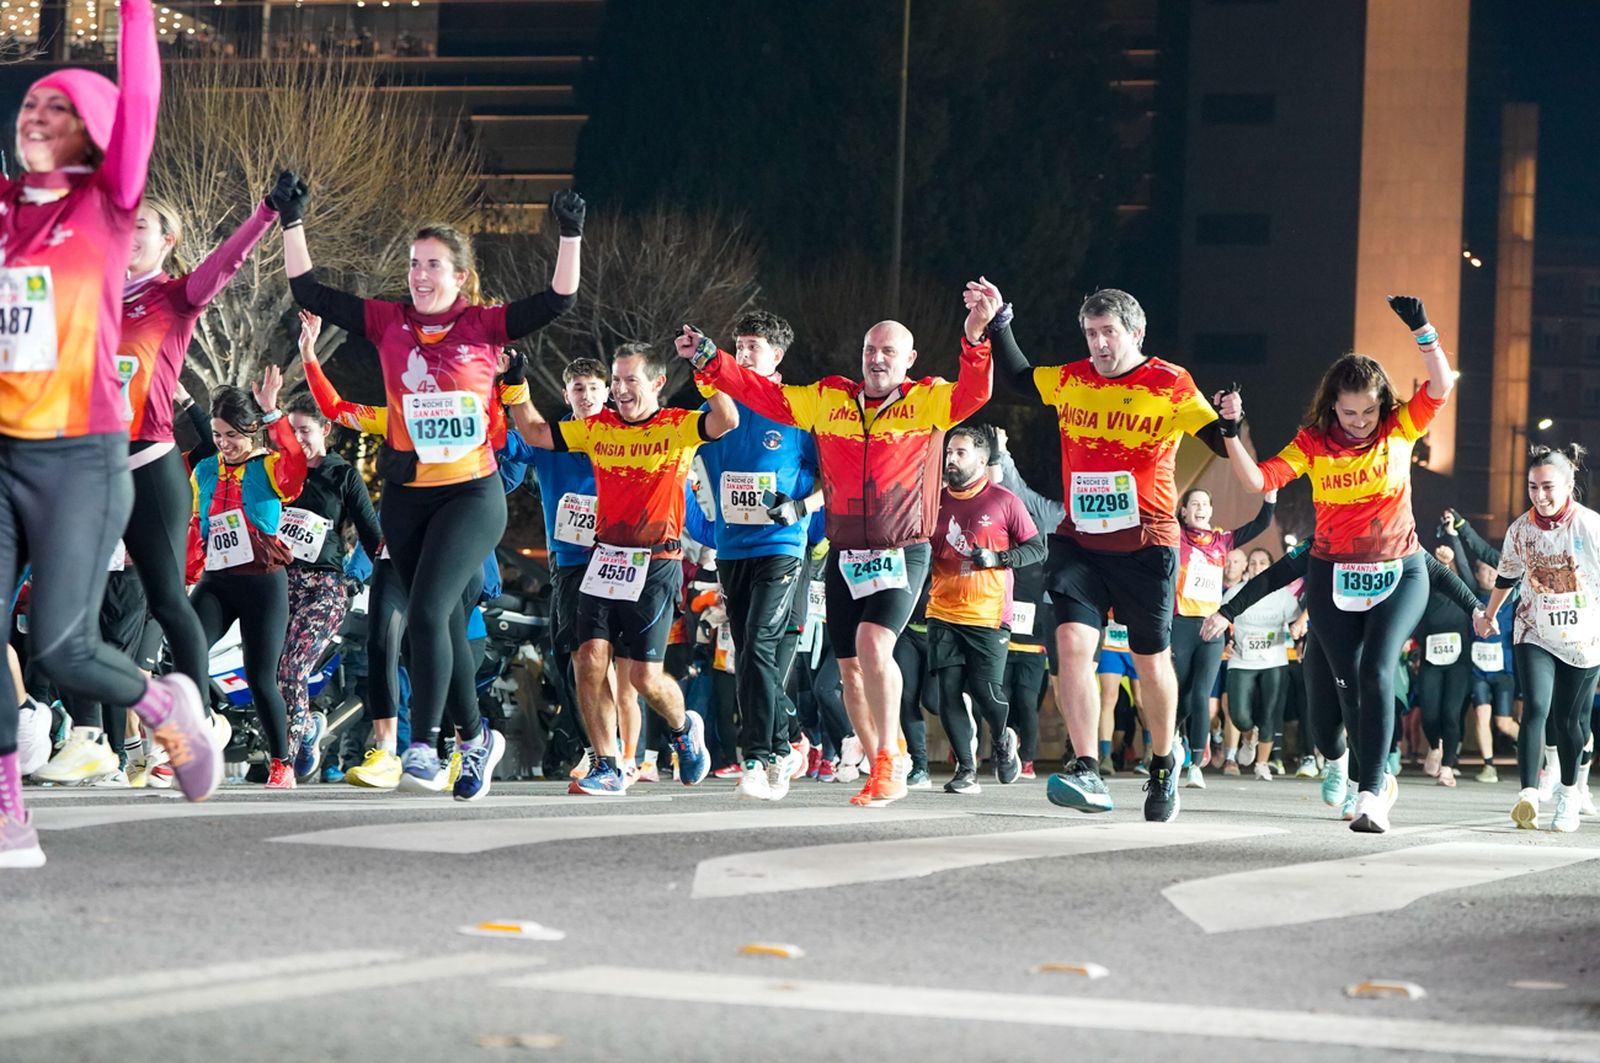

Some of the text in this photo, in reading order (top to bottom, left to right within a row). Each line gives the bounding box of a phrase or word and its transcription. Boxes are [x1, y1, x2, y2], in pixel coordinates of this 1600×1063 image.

[413, 410, 429, 418] SAN
[422, 400, 453, 408] NOCHE DE
[414, 417, 475, 439] 13209
[1107, 410, 1164, 437] VIVA!
[630, 438, 669, 458] VIVA!
[1321, 468, 1370, 491] ¡ANSIA
[1078, 493, 1129, 513] 12298
[568, 510, 595, 530] 7123
[280, 522, 314, 544] 4865
[598, 563, 637, 583] 4550
[852, 556, 893, 578] 2434
[1341, 563, 1355, 571] SAN
[1341, 571, 1395, 592] 13930
[1548, 609, 1578, 626] 1173
